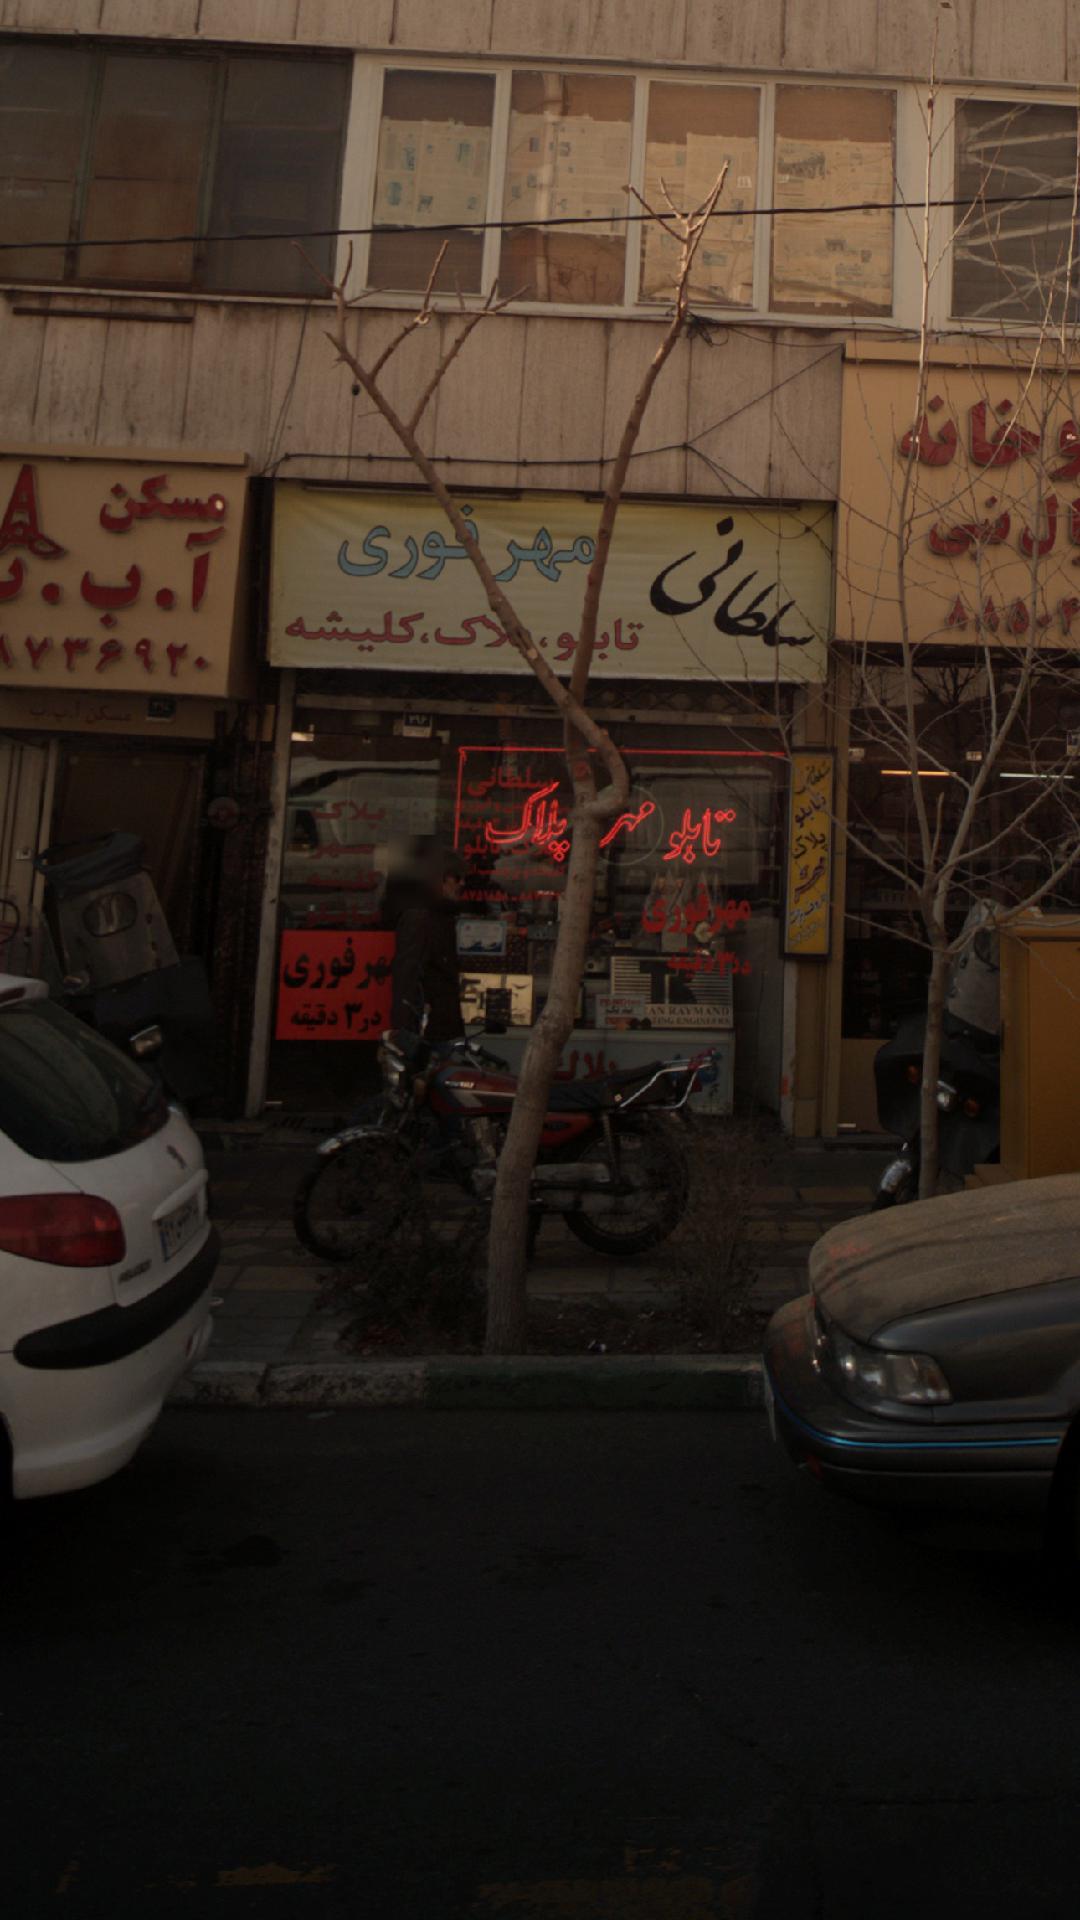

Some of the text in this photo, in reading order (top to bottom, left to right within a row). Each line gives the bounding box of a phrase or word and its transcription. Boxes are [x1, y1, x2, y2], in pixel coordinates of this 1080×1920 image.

[99, 474, 225, 533] مسکن
[337, 505, 597, 582] مهر فوری
[650, 516, 815, 646] سلطانی
[284, 611, 425, 653] کلیشه
[484, 779, 737, 864] تابلو مهر پلاک
[641, 883, 709, 934] فوری
[704, 899, 752, 934] مهر
[284, 937, 356, 989] فوری
[291, 1002, 383, 1034] در ۳ دقیقه
